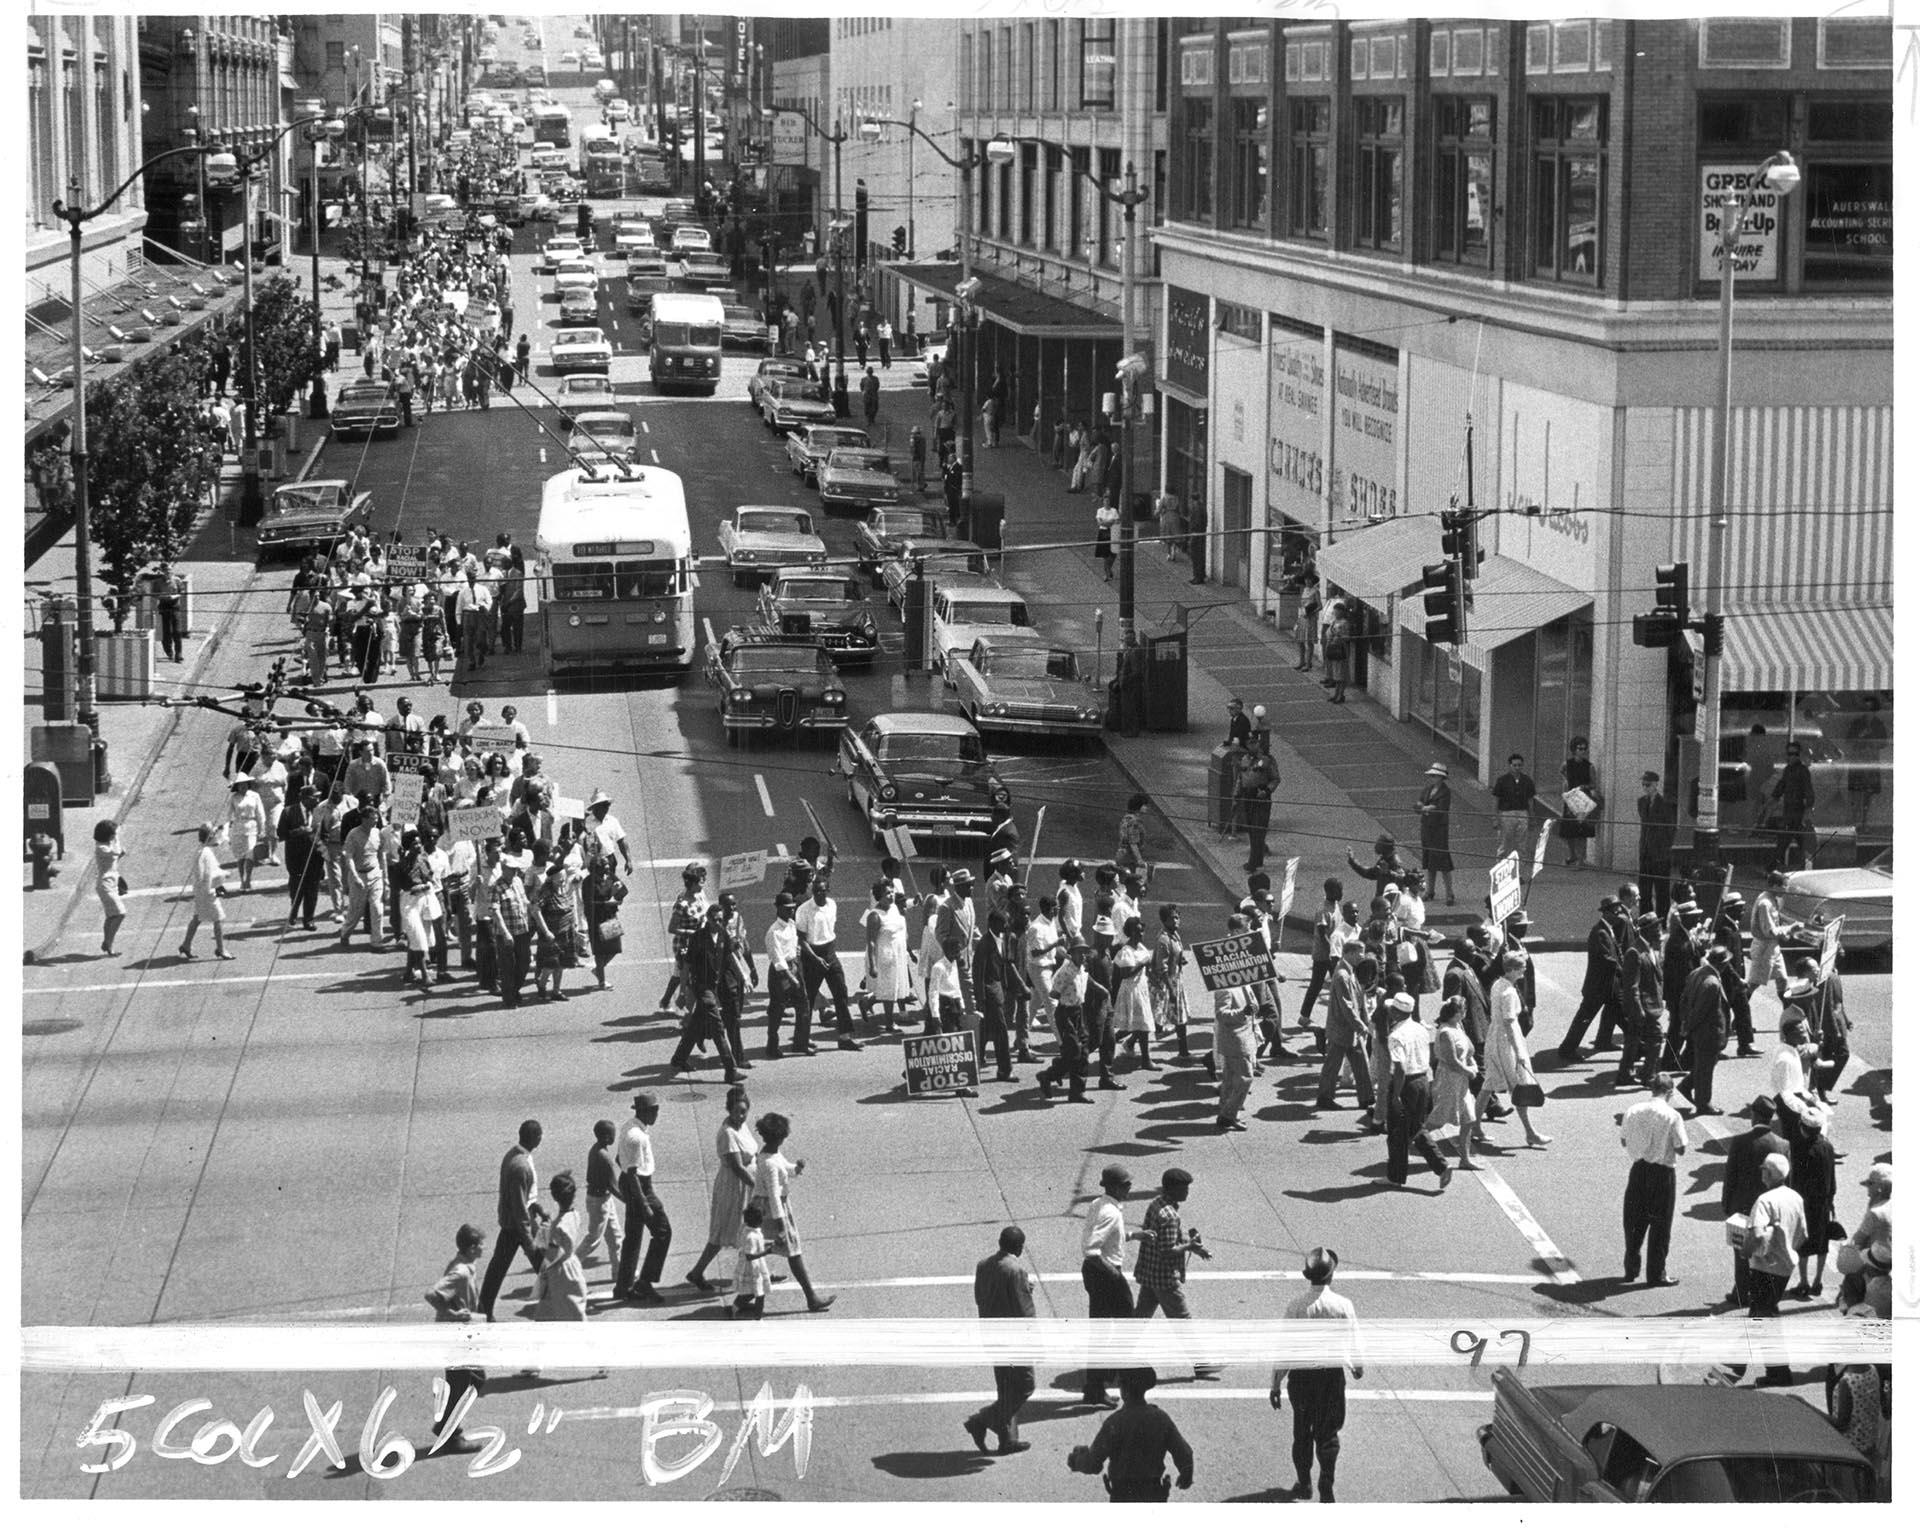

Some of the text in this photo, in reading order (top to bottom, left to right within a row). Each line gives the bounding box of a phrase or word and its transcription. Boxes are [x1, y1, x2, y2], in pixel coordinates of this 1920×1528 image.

[737, 17, 746, 73] OTEL
[773, 136, 804, 144] TUCKER
[1846, 233, 1888, 245] SCHOOL
[390, 547, 421, 556] STOP
[390, 566, 423, 577] NOW!
[393, 755, 430, 766] STOP
[459, 823, 498, 836] NOW
[1202, 936, 1252, 958] STOP
[1202, 952, 1269, 976] DISCRIMINATION
[1215, 949, 1253, 964] RACIAL
[1212, 964, 1270, 988] NOW!
[911, 1035, 965, 1057] NOW!
[908, 1050, 974, 1070] DISCRIMINATION
[922, 1063, 958, 1076] RACIAL
[920, 1071, 969, 1090] STOP
